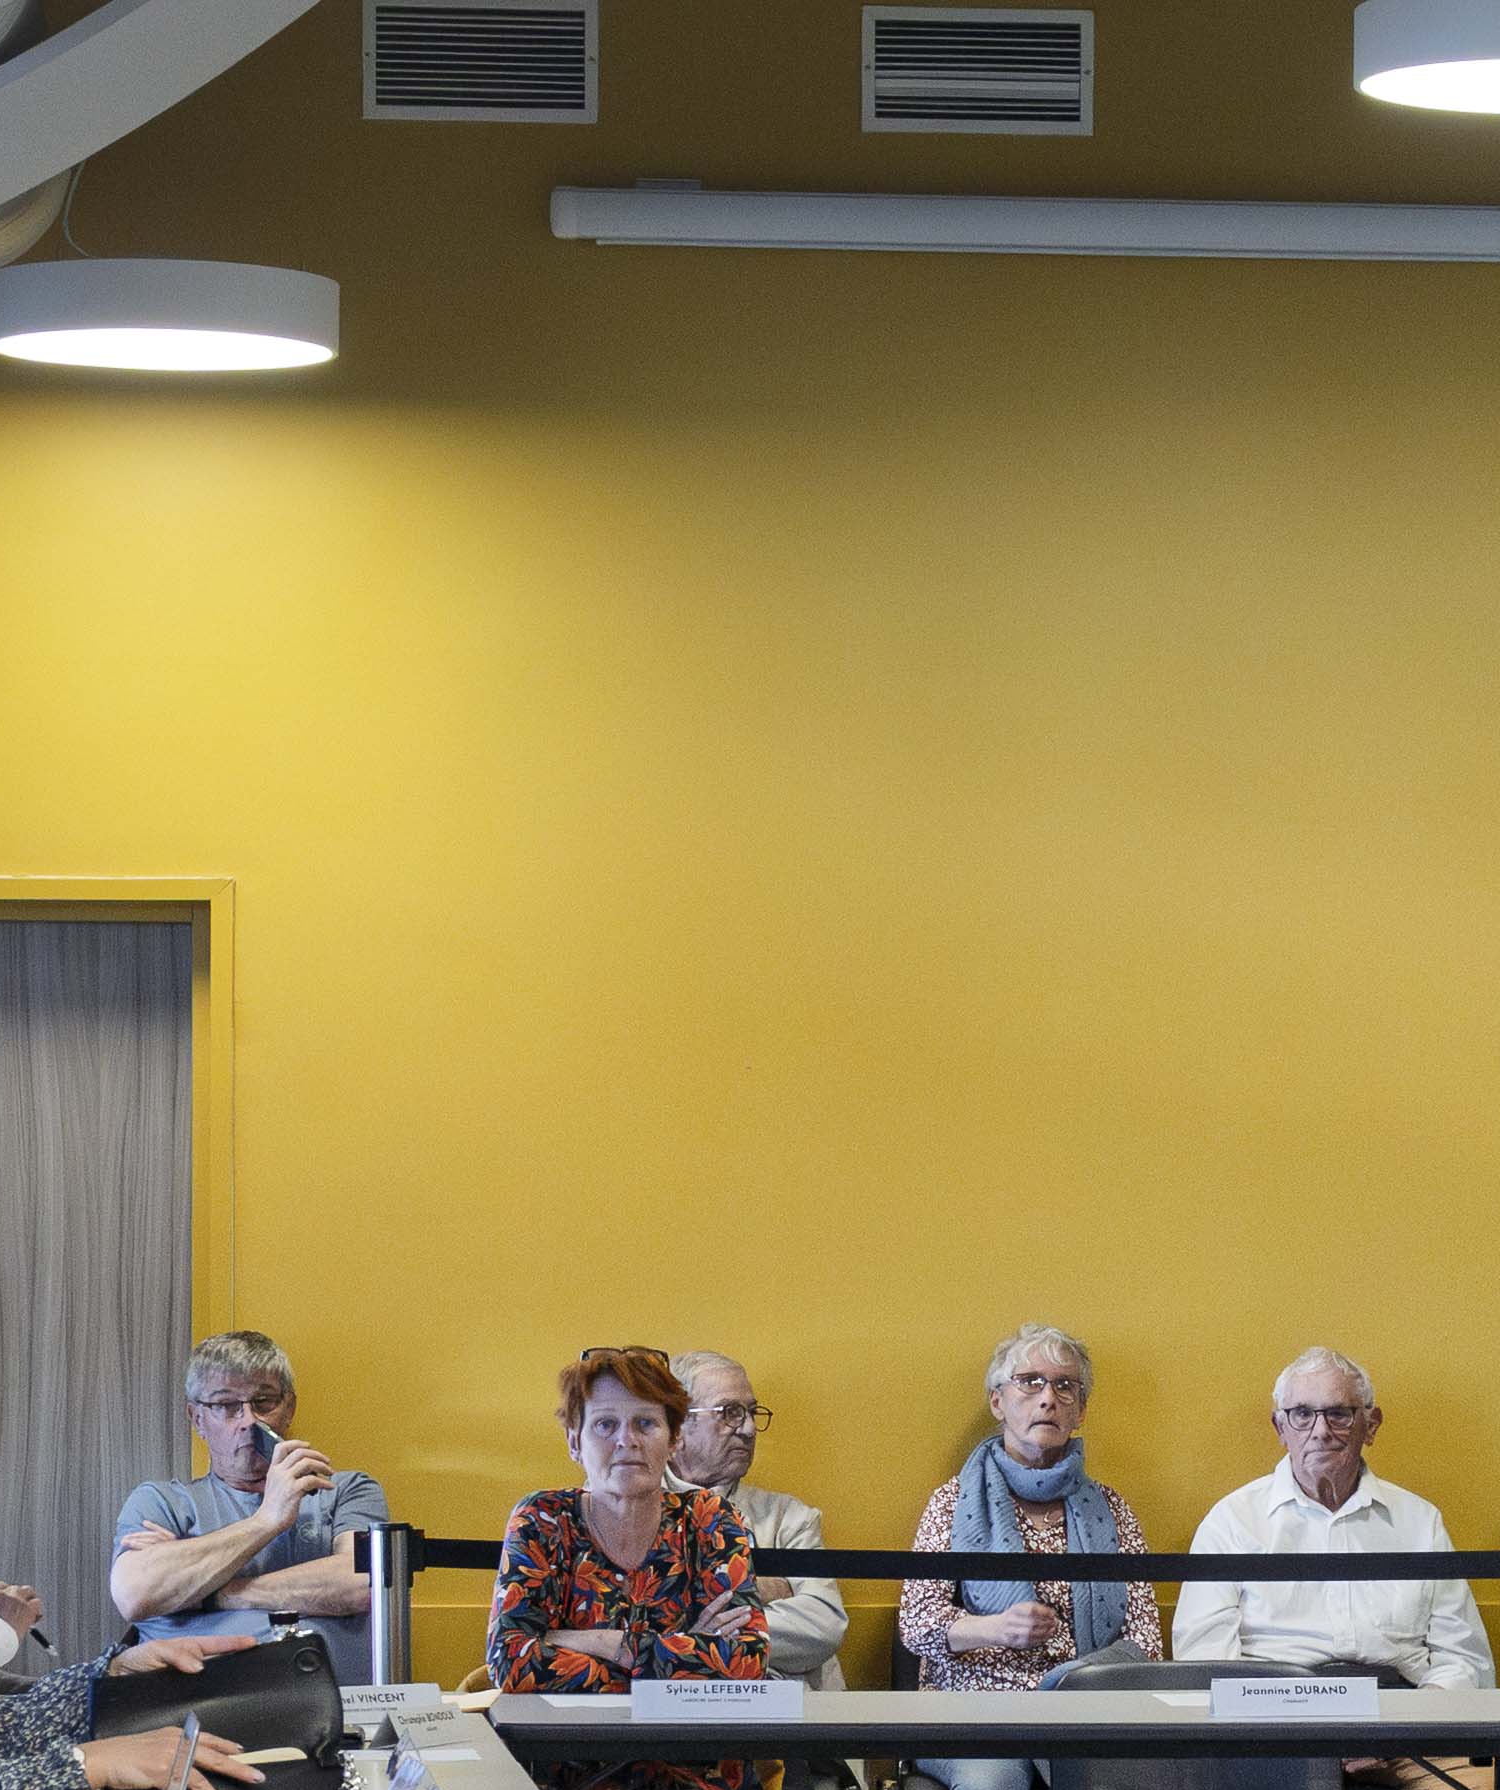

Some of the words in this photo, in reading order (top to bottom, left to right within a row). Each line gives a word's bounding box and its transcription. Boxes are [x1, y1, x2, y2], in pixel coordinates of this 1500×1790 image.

[666, 1684, 699, 1695] Sylvie
[704, 1684, 768, 1694] LEFEBVRE
[1242, 1686, 1291, 1697] Jeannine
[1295, 1685, 1348, 1695] DURAND
[357, 1692, 405, 1703] VINCENT
